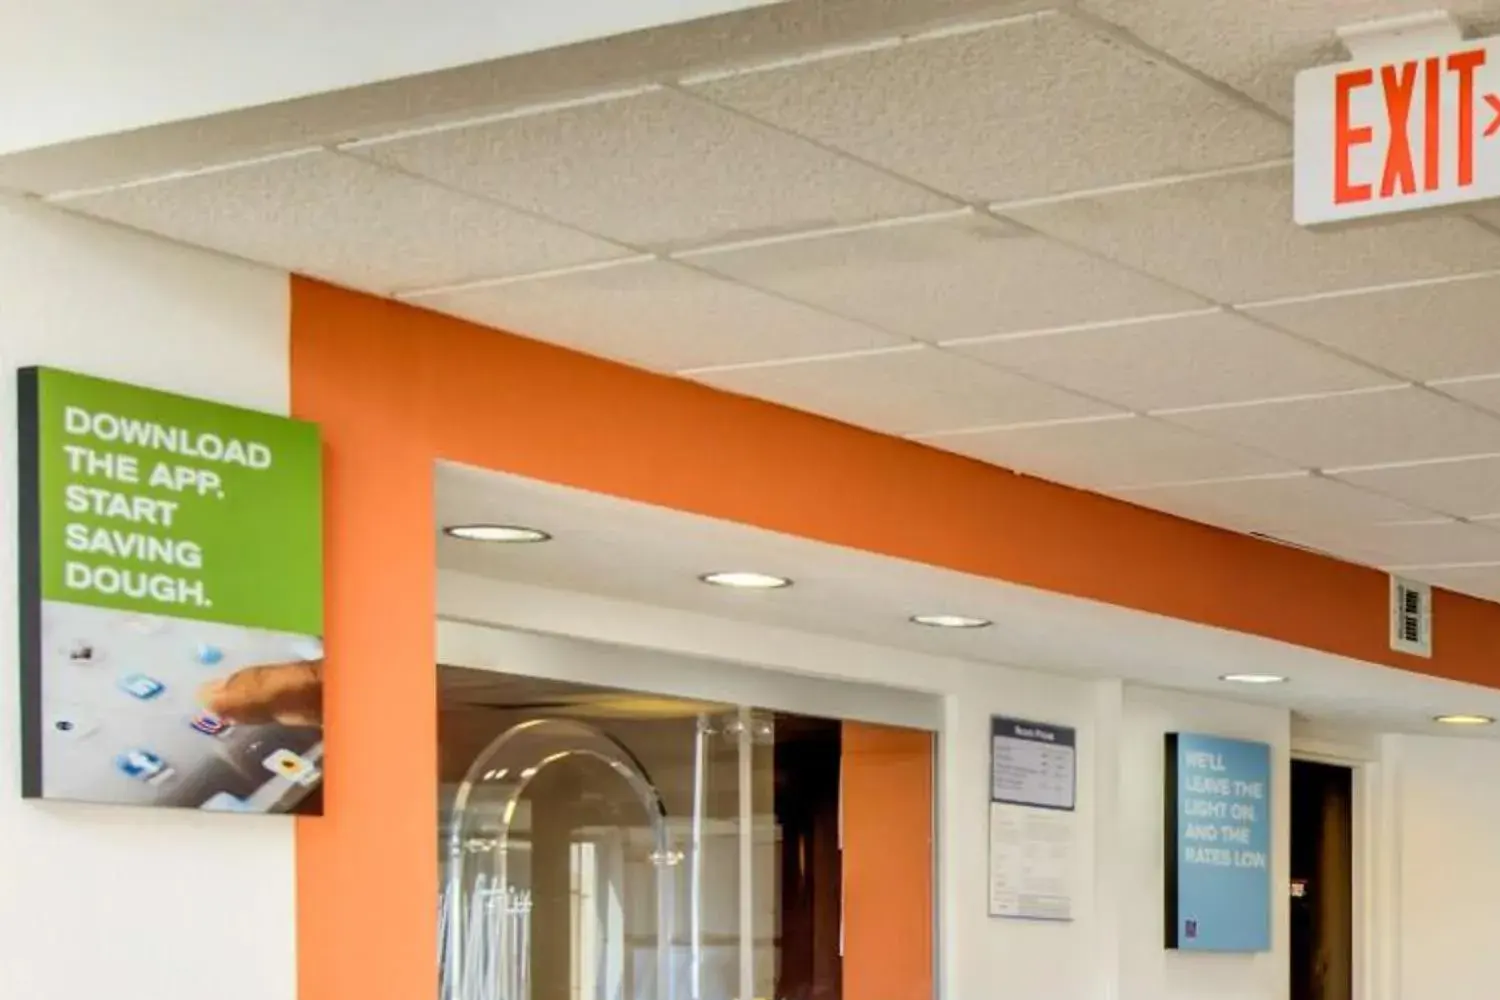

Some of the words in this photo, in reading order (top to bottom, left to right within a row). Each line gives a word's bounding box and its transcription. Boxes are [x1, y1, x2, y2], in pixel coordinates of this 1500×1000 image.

[1334, 48, 1486, 205] EXIT
[64, 406, 271, 470] DOWNLOAD
[64, 444, 140, 483] THE
[149, 461, 225, 499] APP.
[65, 485, 178, 527] START
[65, 523, 203, 568] SAVING
[65, 561, 213, 607] DOUGH.
[1184, 798, 1228, 818] LIGHT
[1185, 775, 1231, 796] LEAVE
[1233, 781, 1263, 799] THE
[1185, 822, 1218, 841] AND
[1221, 825, 1250, 844] THE
[1185, 847, 1232, 866] RATES
